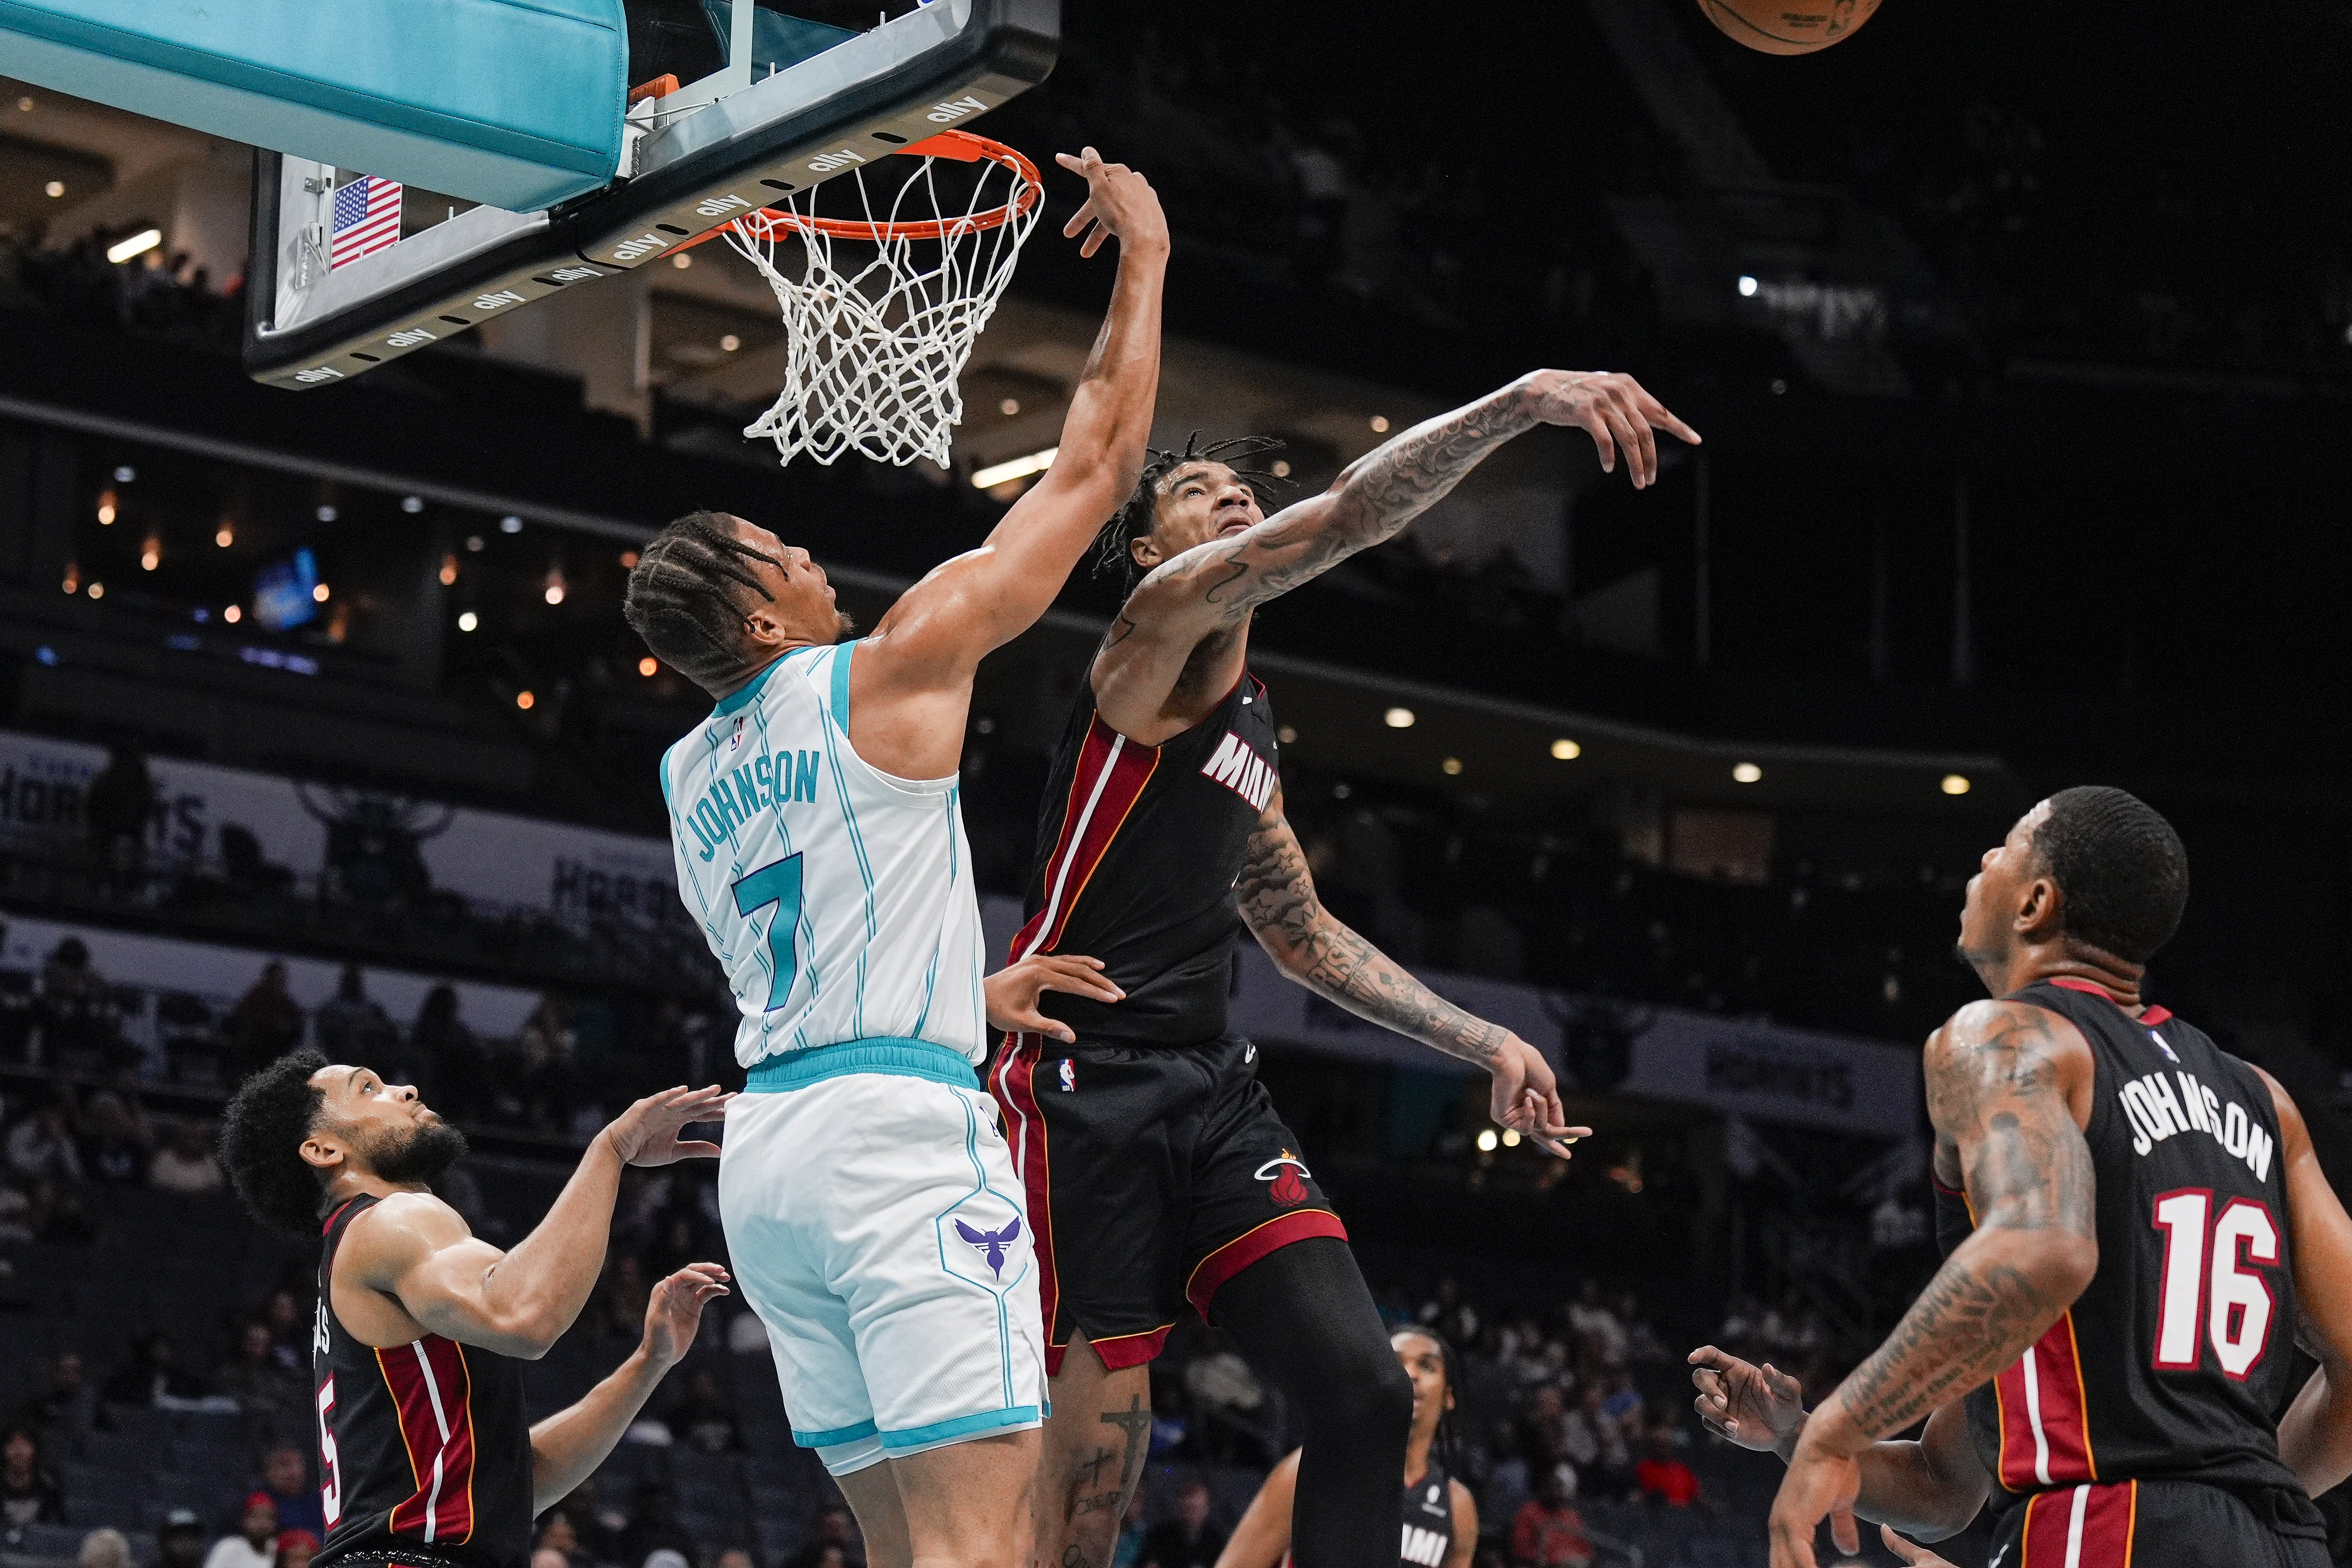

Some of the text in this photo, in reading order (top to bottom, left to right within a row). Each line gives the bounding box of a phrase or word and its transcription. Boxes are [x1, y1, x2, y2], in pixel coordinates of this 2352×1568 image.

[927, 95, 989, 122] ally
[808, 148, 867, 172] ally
[696, 193, 753, 216] ally
[613, 233, 669, 260] ally
[552, 266, 604, 281] ally
[473, 290, 526, 310] ally
[387, 327, 438, 347] ally
[295, 366, 344, 383] ally
[687, 750, 820, 863] JOHNSON
[731, 851, 803, 1013] 7
[2119, 1070, 2274, 1183] JOHNSON
[2153, 1187, 2280, 1381] 16
